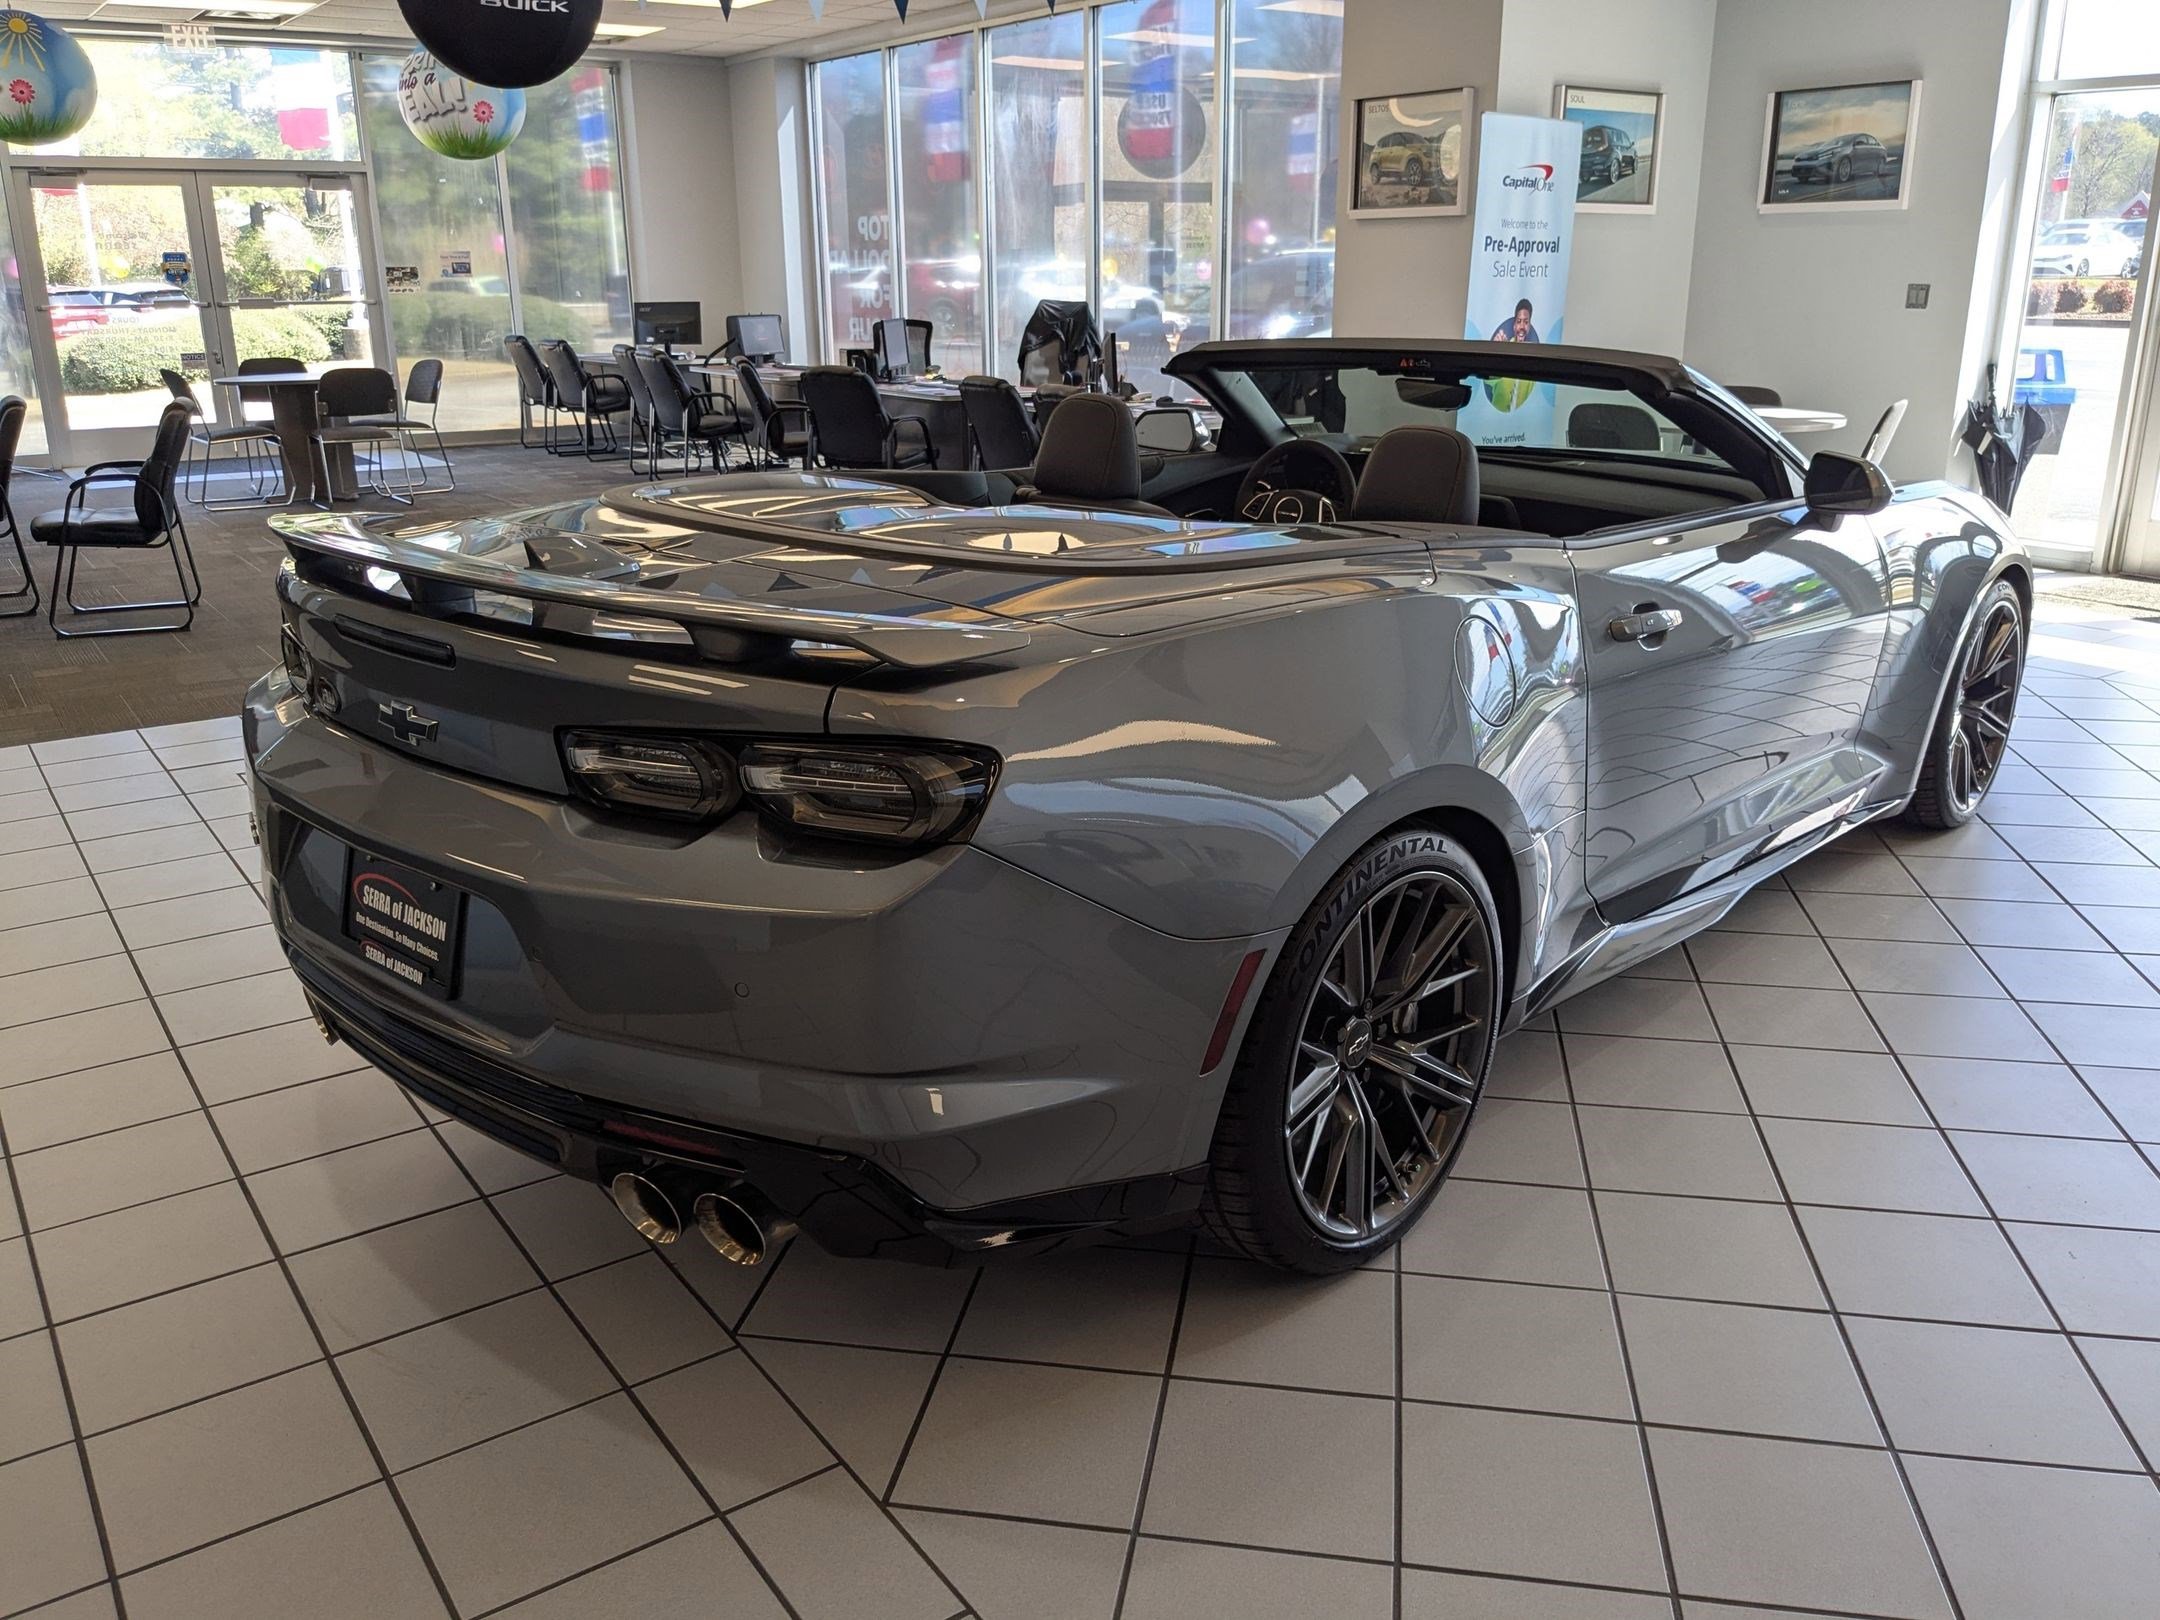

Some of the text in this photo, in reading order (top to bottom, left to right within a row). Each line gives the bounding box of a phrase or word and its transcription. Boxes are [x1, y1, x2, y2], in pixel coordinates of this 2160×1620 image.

[171, 25, 209, 48] EXIT
[424, 71, 437, 86] a
[404, 77, 467, 123] EAL!
[1368, 103, 1390, 113] SELTOS
[1570, 94, 1585, 104] SOUL
[1502, 175, 1537, 189] Capital
[1501, 219, 1549, 230] Welcome to the
[1484, 236, 1560, 257] Pre-Approval
[1493, 260, 1549, 278] Sale Event
[1482, 435, 1503, 444] You've
[363, 885, 447, 941] SERRA of JACKSON
[1288, 837, 1448, 995] CONTINENTAL
[355, 912, 440, 961] One Destination. So Many Choices.
[365, 945, 424, 985] SERRA of JACKSON
